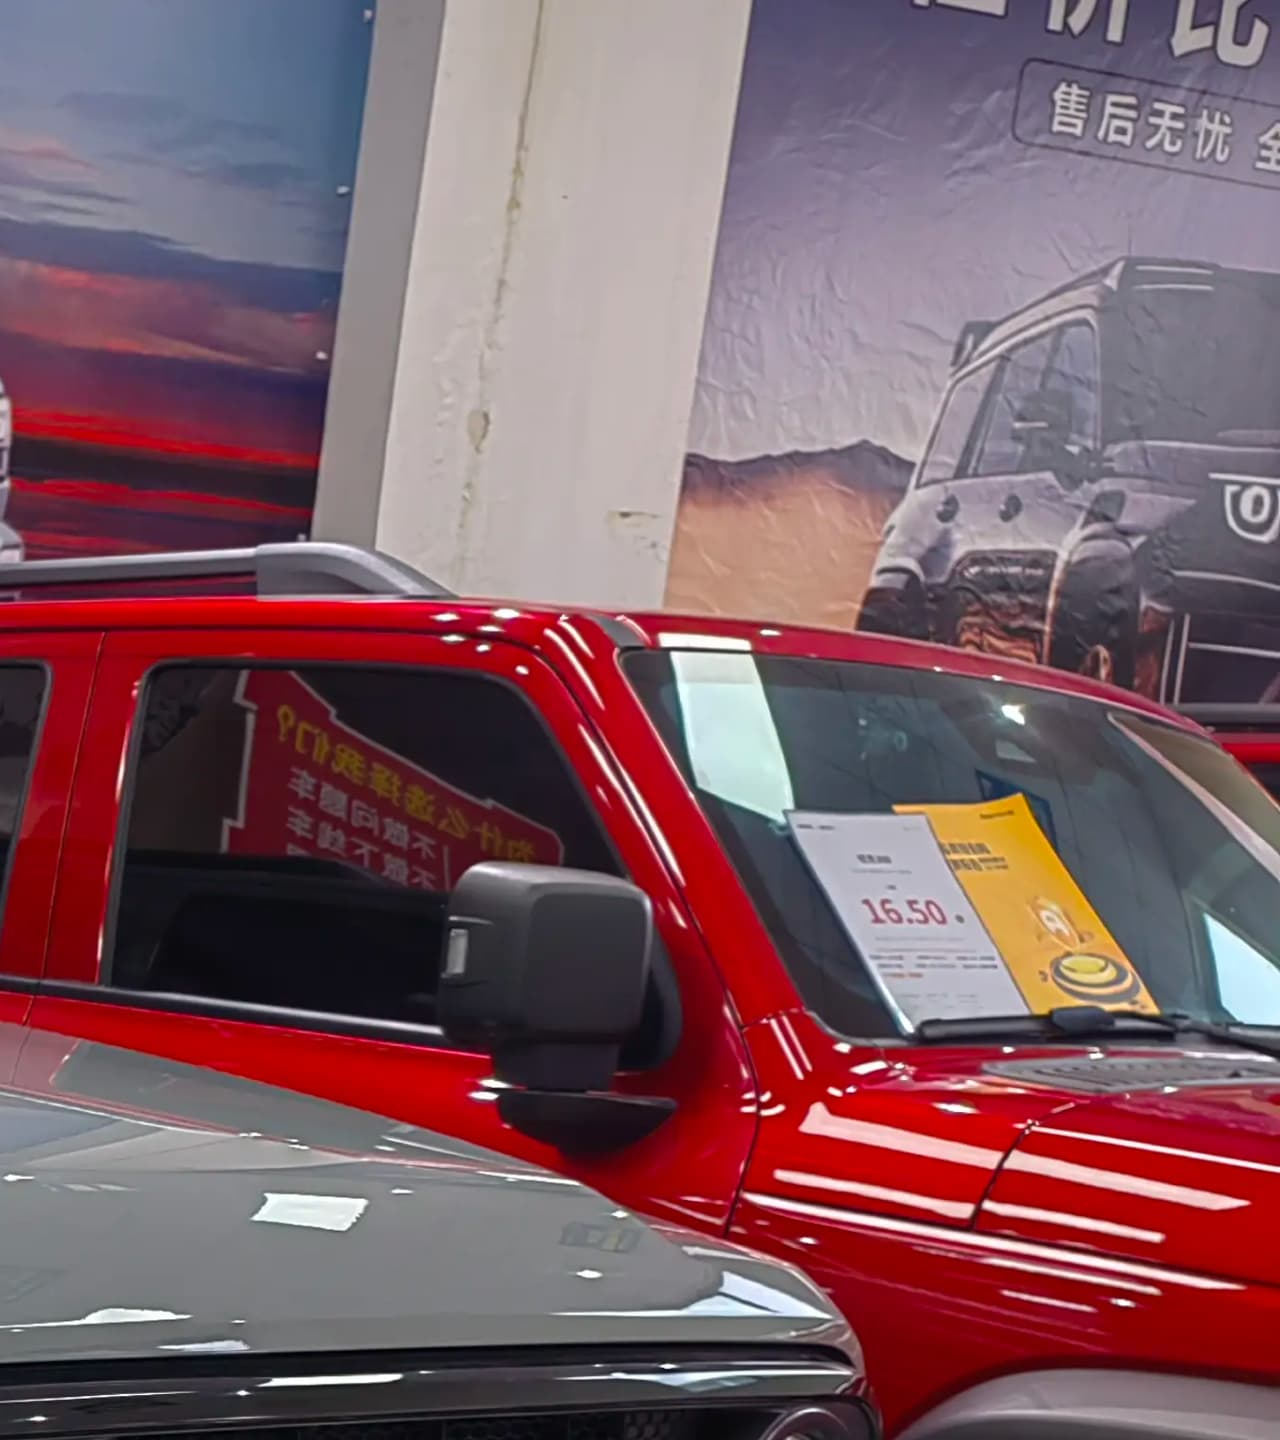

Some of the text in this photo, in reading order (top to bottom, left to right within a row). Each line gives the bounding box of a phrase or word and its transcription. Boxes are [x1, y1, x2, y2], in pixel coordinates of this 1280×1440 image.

[1050, 81, 1234, 164] 售后无忧
[862, 898, 948, 926] 16.50
